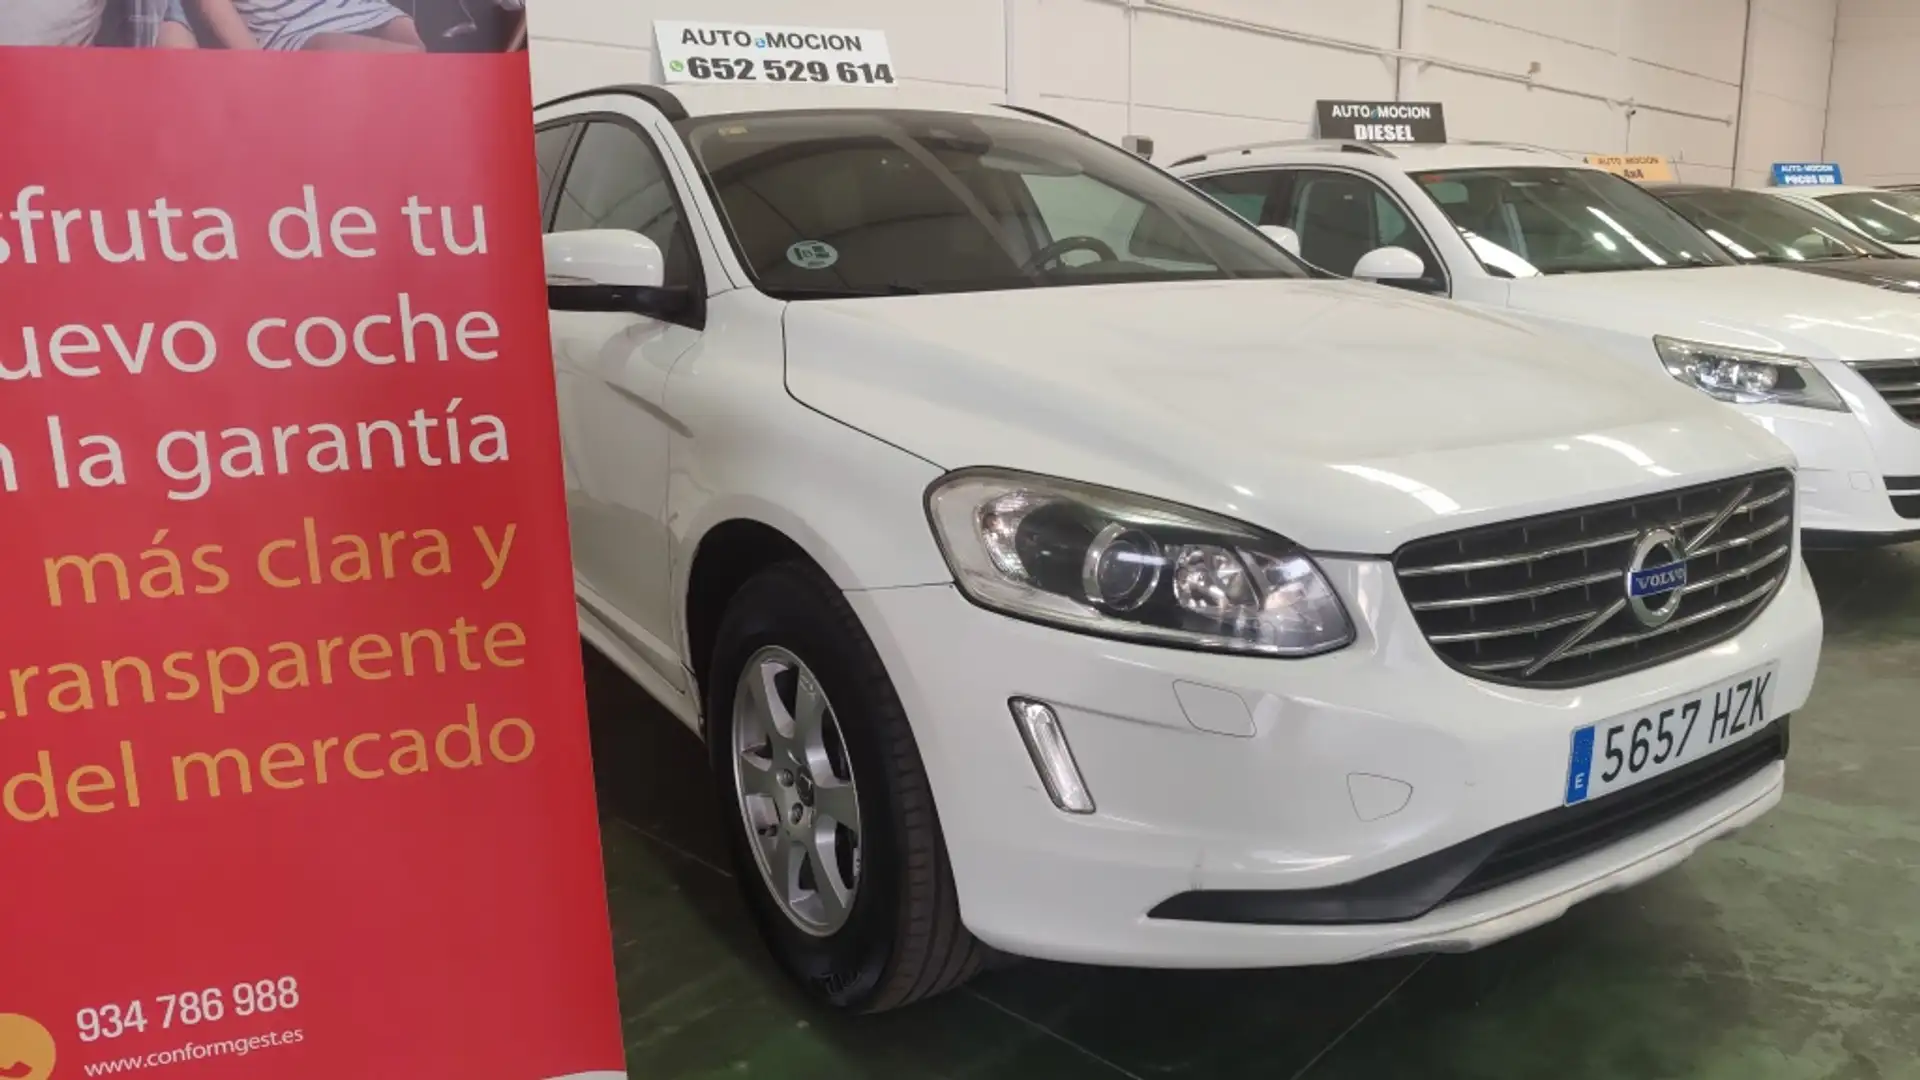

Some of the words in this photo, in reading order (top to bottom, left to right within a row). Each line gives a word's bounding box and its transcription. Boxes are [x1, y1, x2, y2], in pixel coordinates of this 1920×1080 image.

[681, 28, 752, 47] AUTO
[687, 57, 756, 80] 652
[763, 60, 829, 82] 529
[836, 62, 894, 84] 614
[1331, 105, 1370, 118] AUTO
[1354, 124, 1415, 141] DIESEL
[267, 184, 378, 259] de
[401, 194, 488, 257] tu
[246, 292, 500, 369] coche
[47, 415, 126, 489] la
[156, 397, 510, 501] garantía
[43, 528, 230, 607] más
[257, 516, 453, 589] clara
[473, 521, 517, 590] y
[1636, 568, 1685, 589] VOLVO
[0, 616, 527, 720] ransparente
[1601, 699, 1702, 783] 5657
[1708, 671, 1772, 744] HZK
[1, 739, 141, 823] del
[171, 702, 536, 802] mercado
[1574, 772, 1584, 789] E
[76, 1000, 148, 1042] 934
[156, 988, 224, 1028] 786
[232, 976, 300, 1015] 988
[84, 1028, 305, 1078] www.conformgest.es
